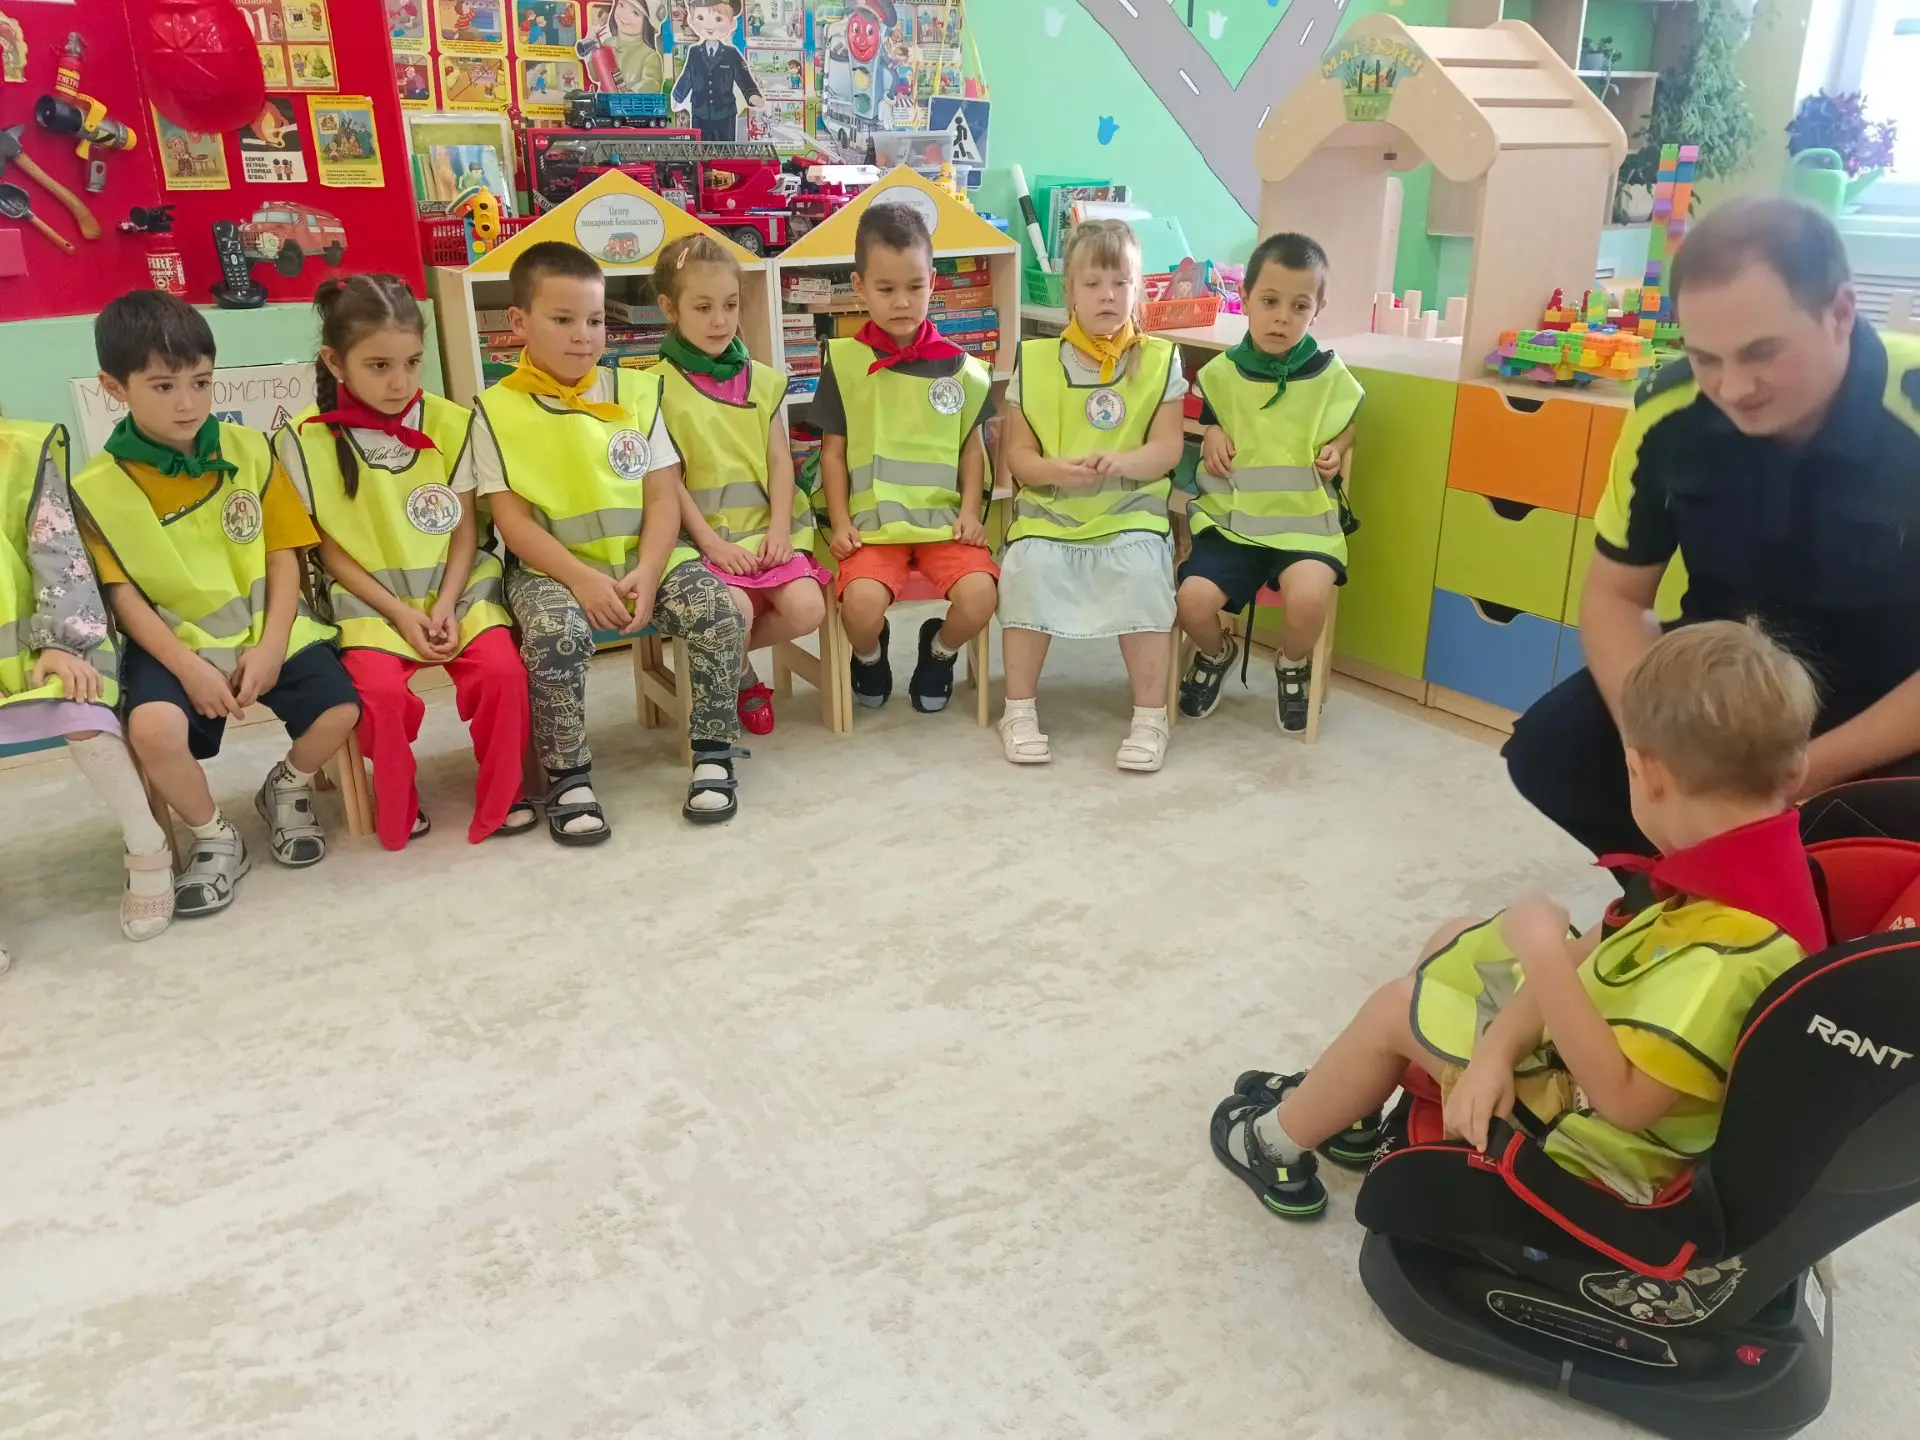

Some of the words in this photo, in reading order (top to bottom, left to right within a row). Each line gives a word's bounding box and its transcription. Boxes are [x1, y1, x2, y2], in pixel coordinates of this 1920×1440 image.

[581, 217, 614, 229] пожарной
[615, 216, 658, 227] безопасности
[609, 206, 630, 218] Центр
[212, 376, 301, 405] ОМСТВО
[1807, 1014, 1914, 1070] RANT
